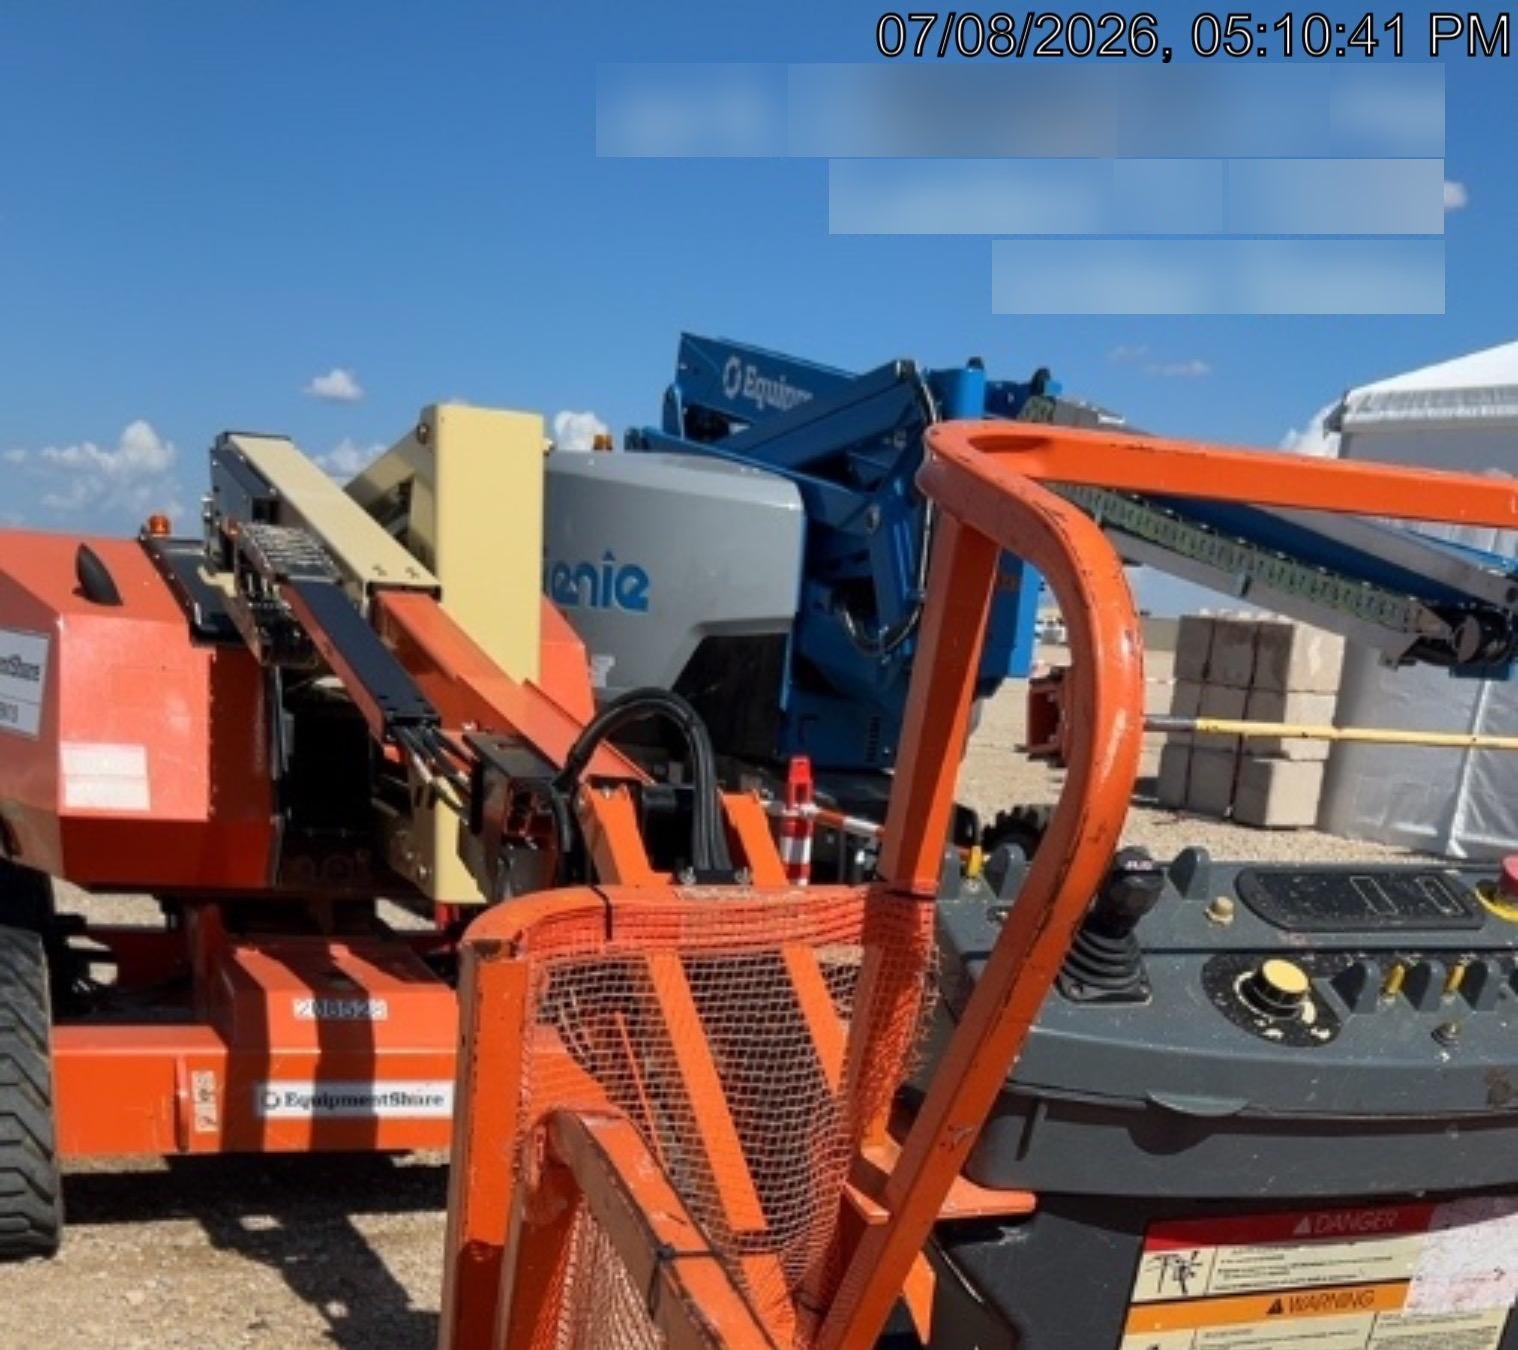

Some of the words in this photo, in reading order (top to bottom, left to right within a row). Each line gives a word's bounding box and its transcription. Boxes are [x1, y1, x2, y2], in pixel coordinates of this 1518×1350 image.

[550, 549, 650, 614] enie
[284, 1090, 446, 1111] EquipmentShare
[1312, 1209, 1399, 1235] DANGER
[1287, 1289, 1376, 1314] WARNING
